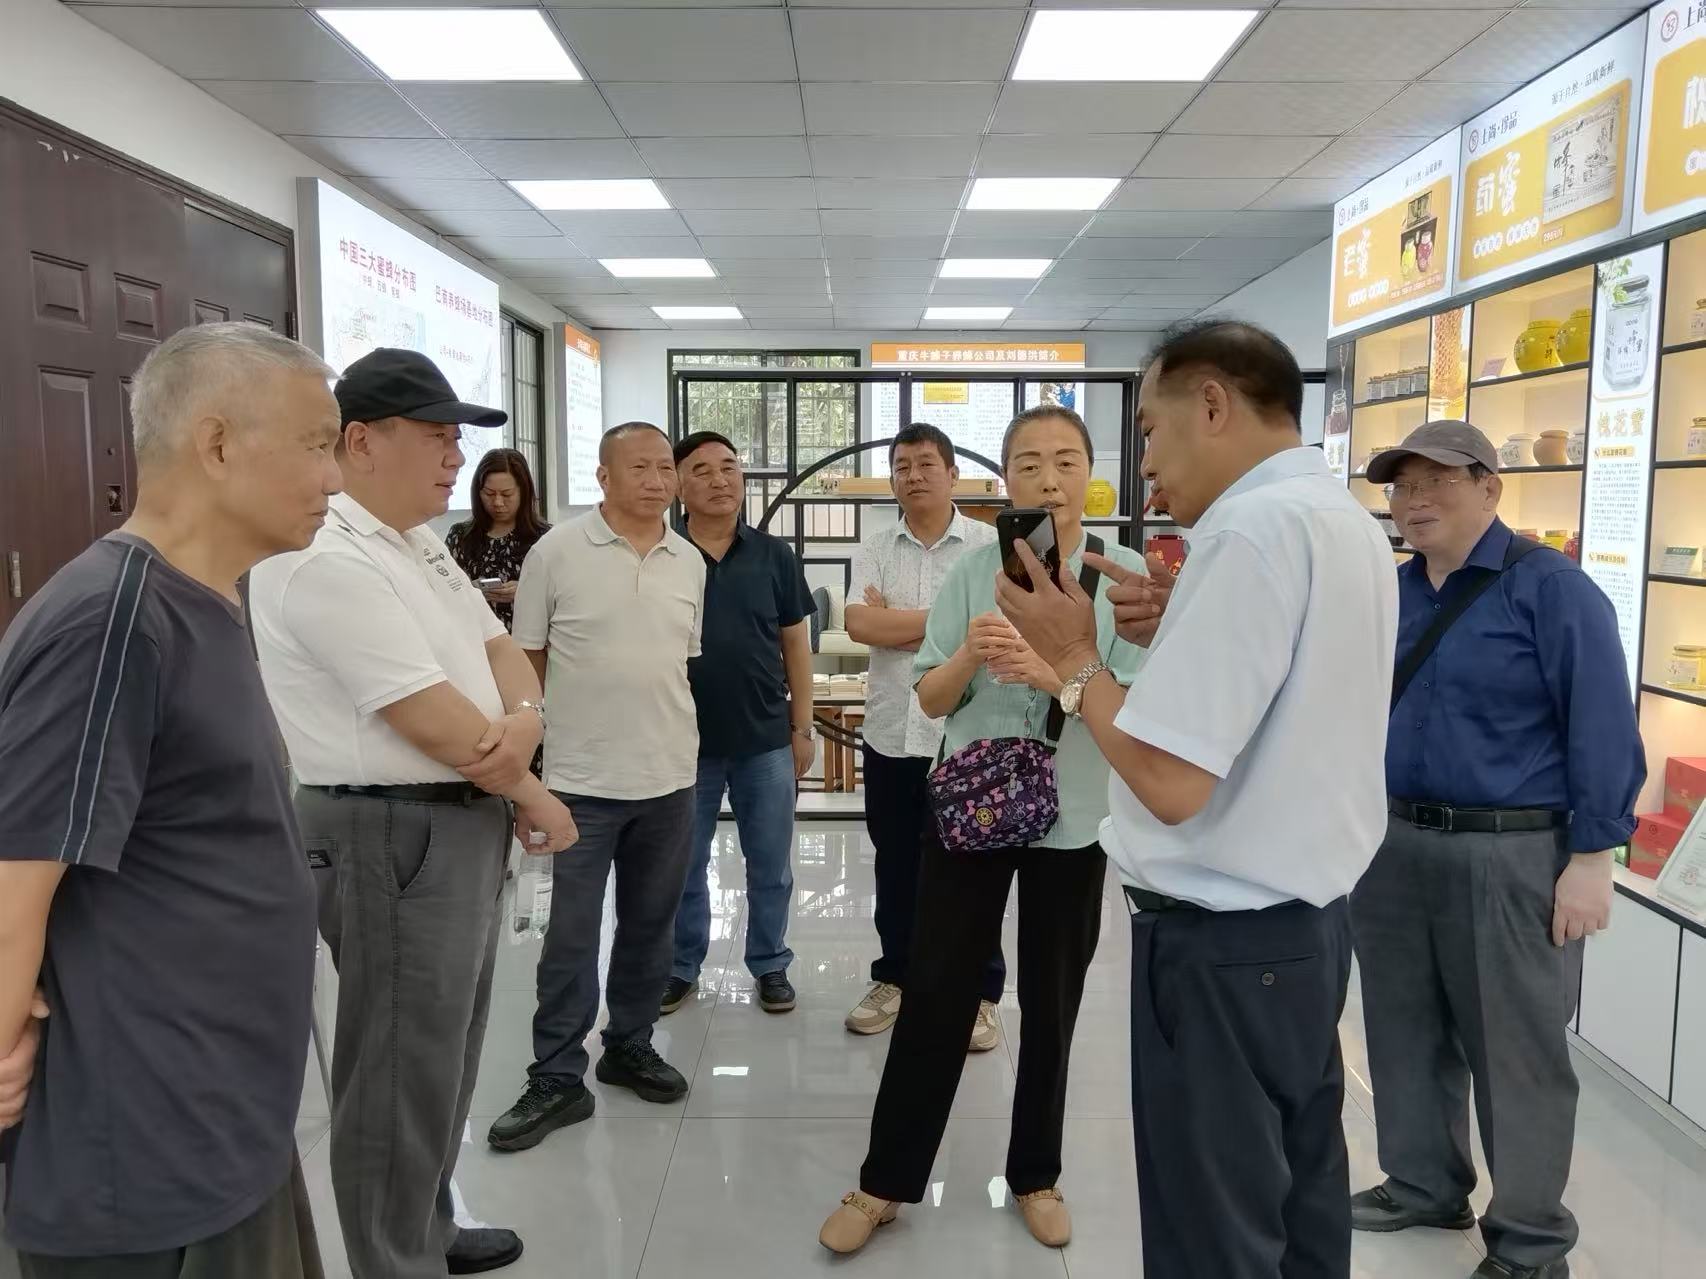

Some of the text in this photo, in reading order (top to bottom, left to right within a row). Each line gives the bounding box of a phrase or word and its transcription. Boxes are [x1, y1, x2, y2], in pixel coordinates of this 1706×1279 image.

[339, 237, 417, 293] 中国三大蜜蜂分布图
